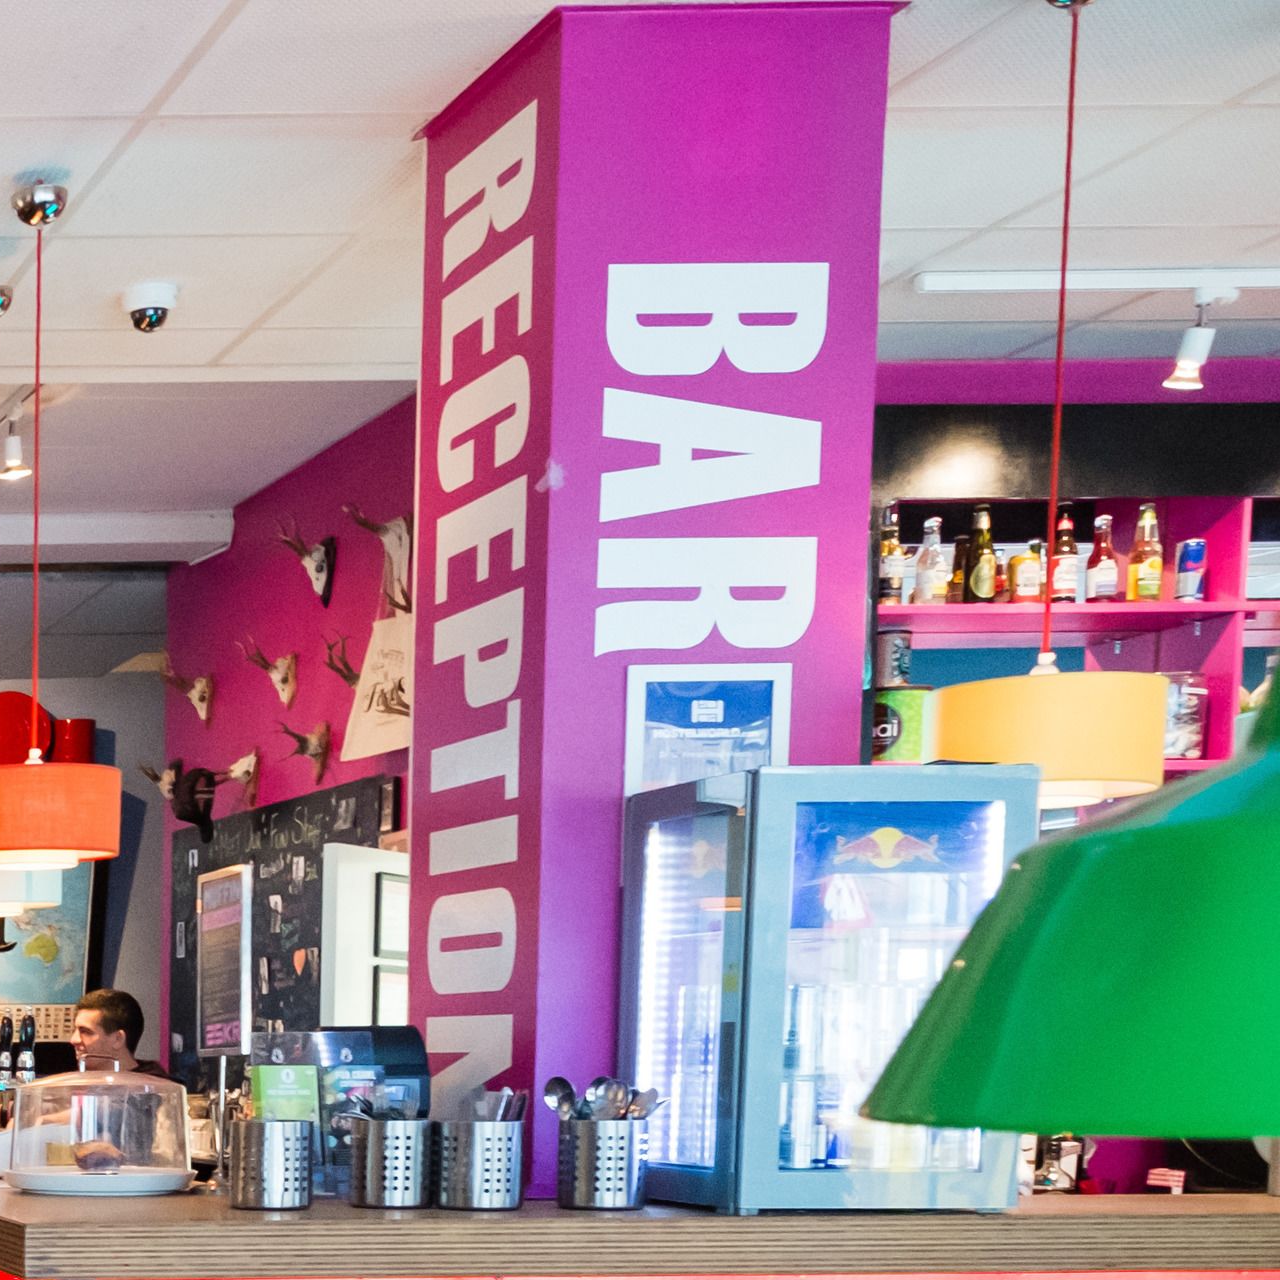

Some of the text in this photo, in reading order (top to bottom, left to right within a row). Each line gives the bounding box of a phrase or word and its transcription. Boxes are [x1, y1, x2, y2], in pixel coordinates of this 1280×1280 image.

[426, 98, 539, 1122] RECEPTION
[594, 262, 831, 657] BAR
[872, 719, 899, 738] ai
